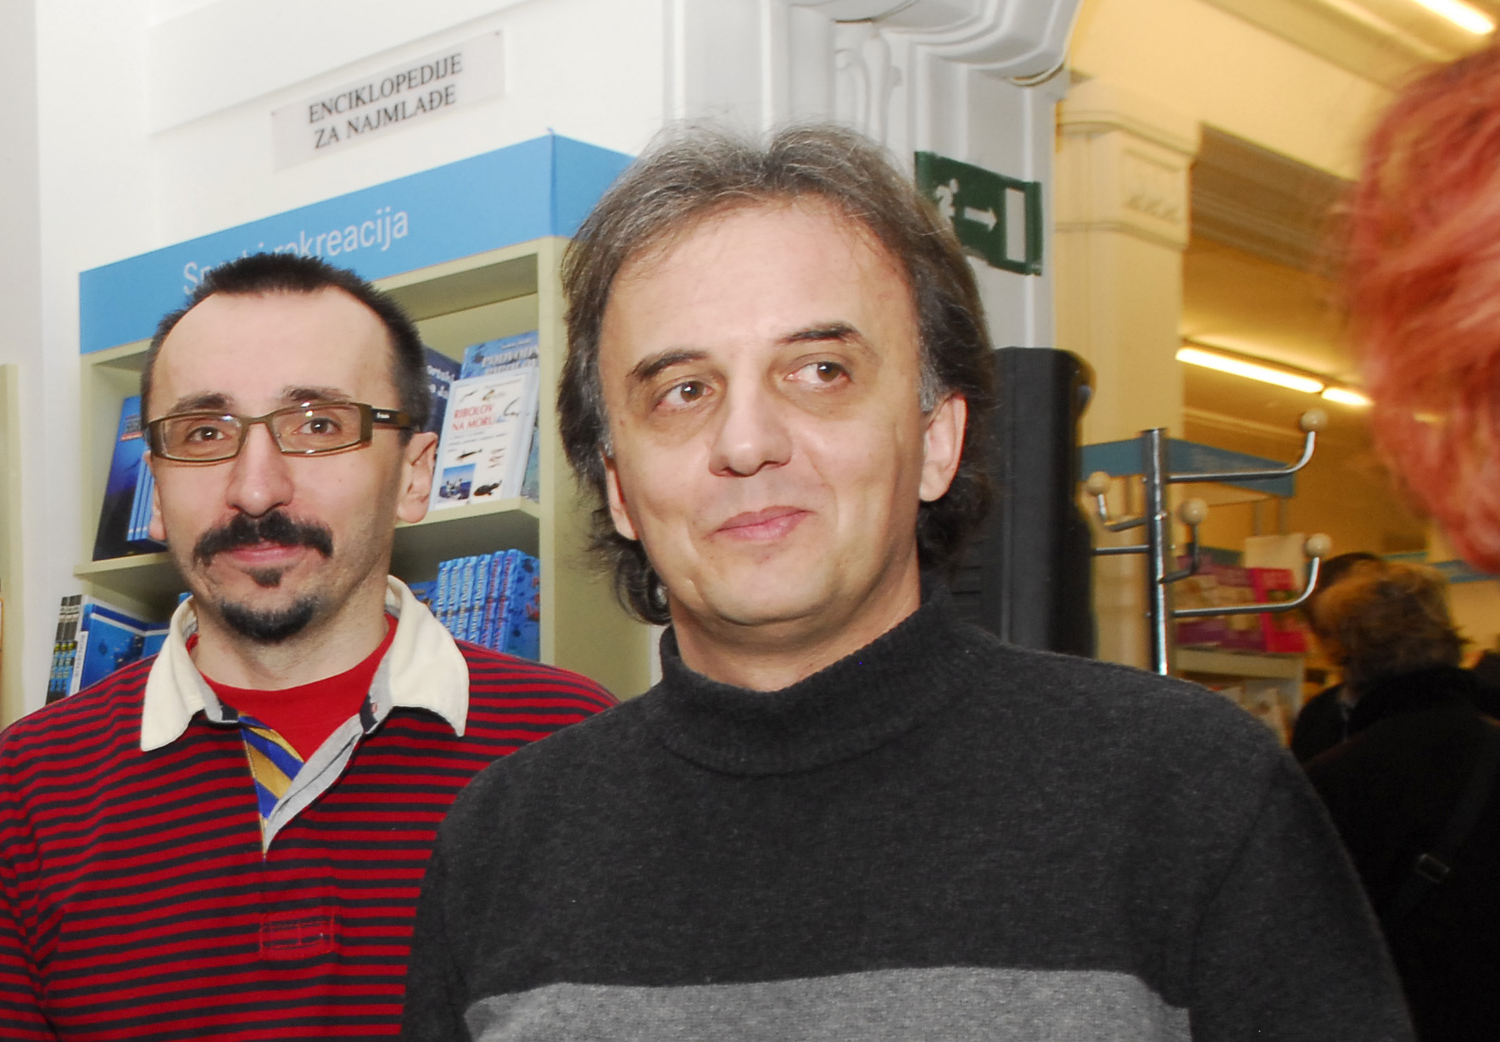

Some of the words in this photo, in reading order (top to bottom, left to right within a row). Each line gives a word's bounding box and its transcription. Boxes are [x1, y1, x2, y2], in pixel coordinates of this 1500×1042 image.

[308, 52, 463, 124] ENCIKLOPEDIJE
[314, 127, 340, 149] ZA
[347, 84, 457, 139] NAJMLAĐE
